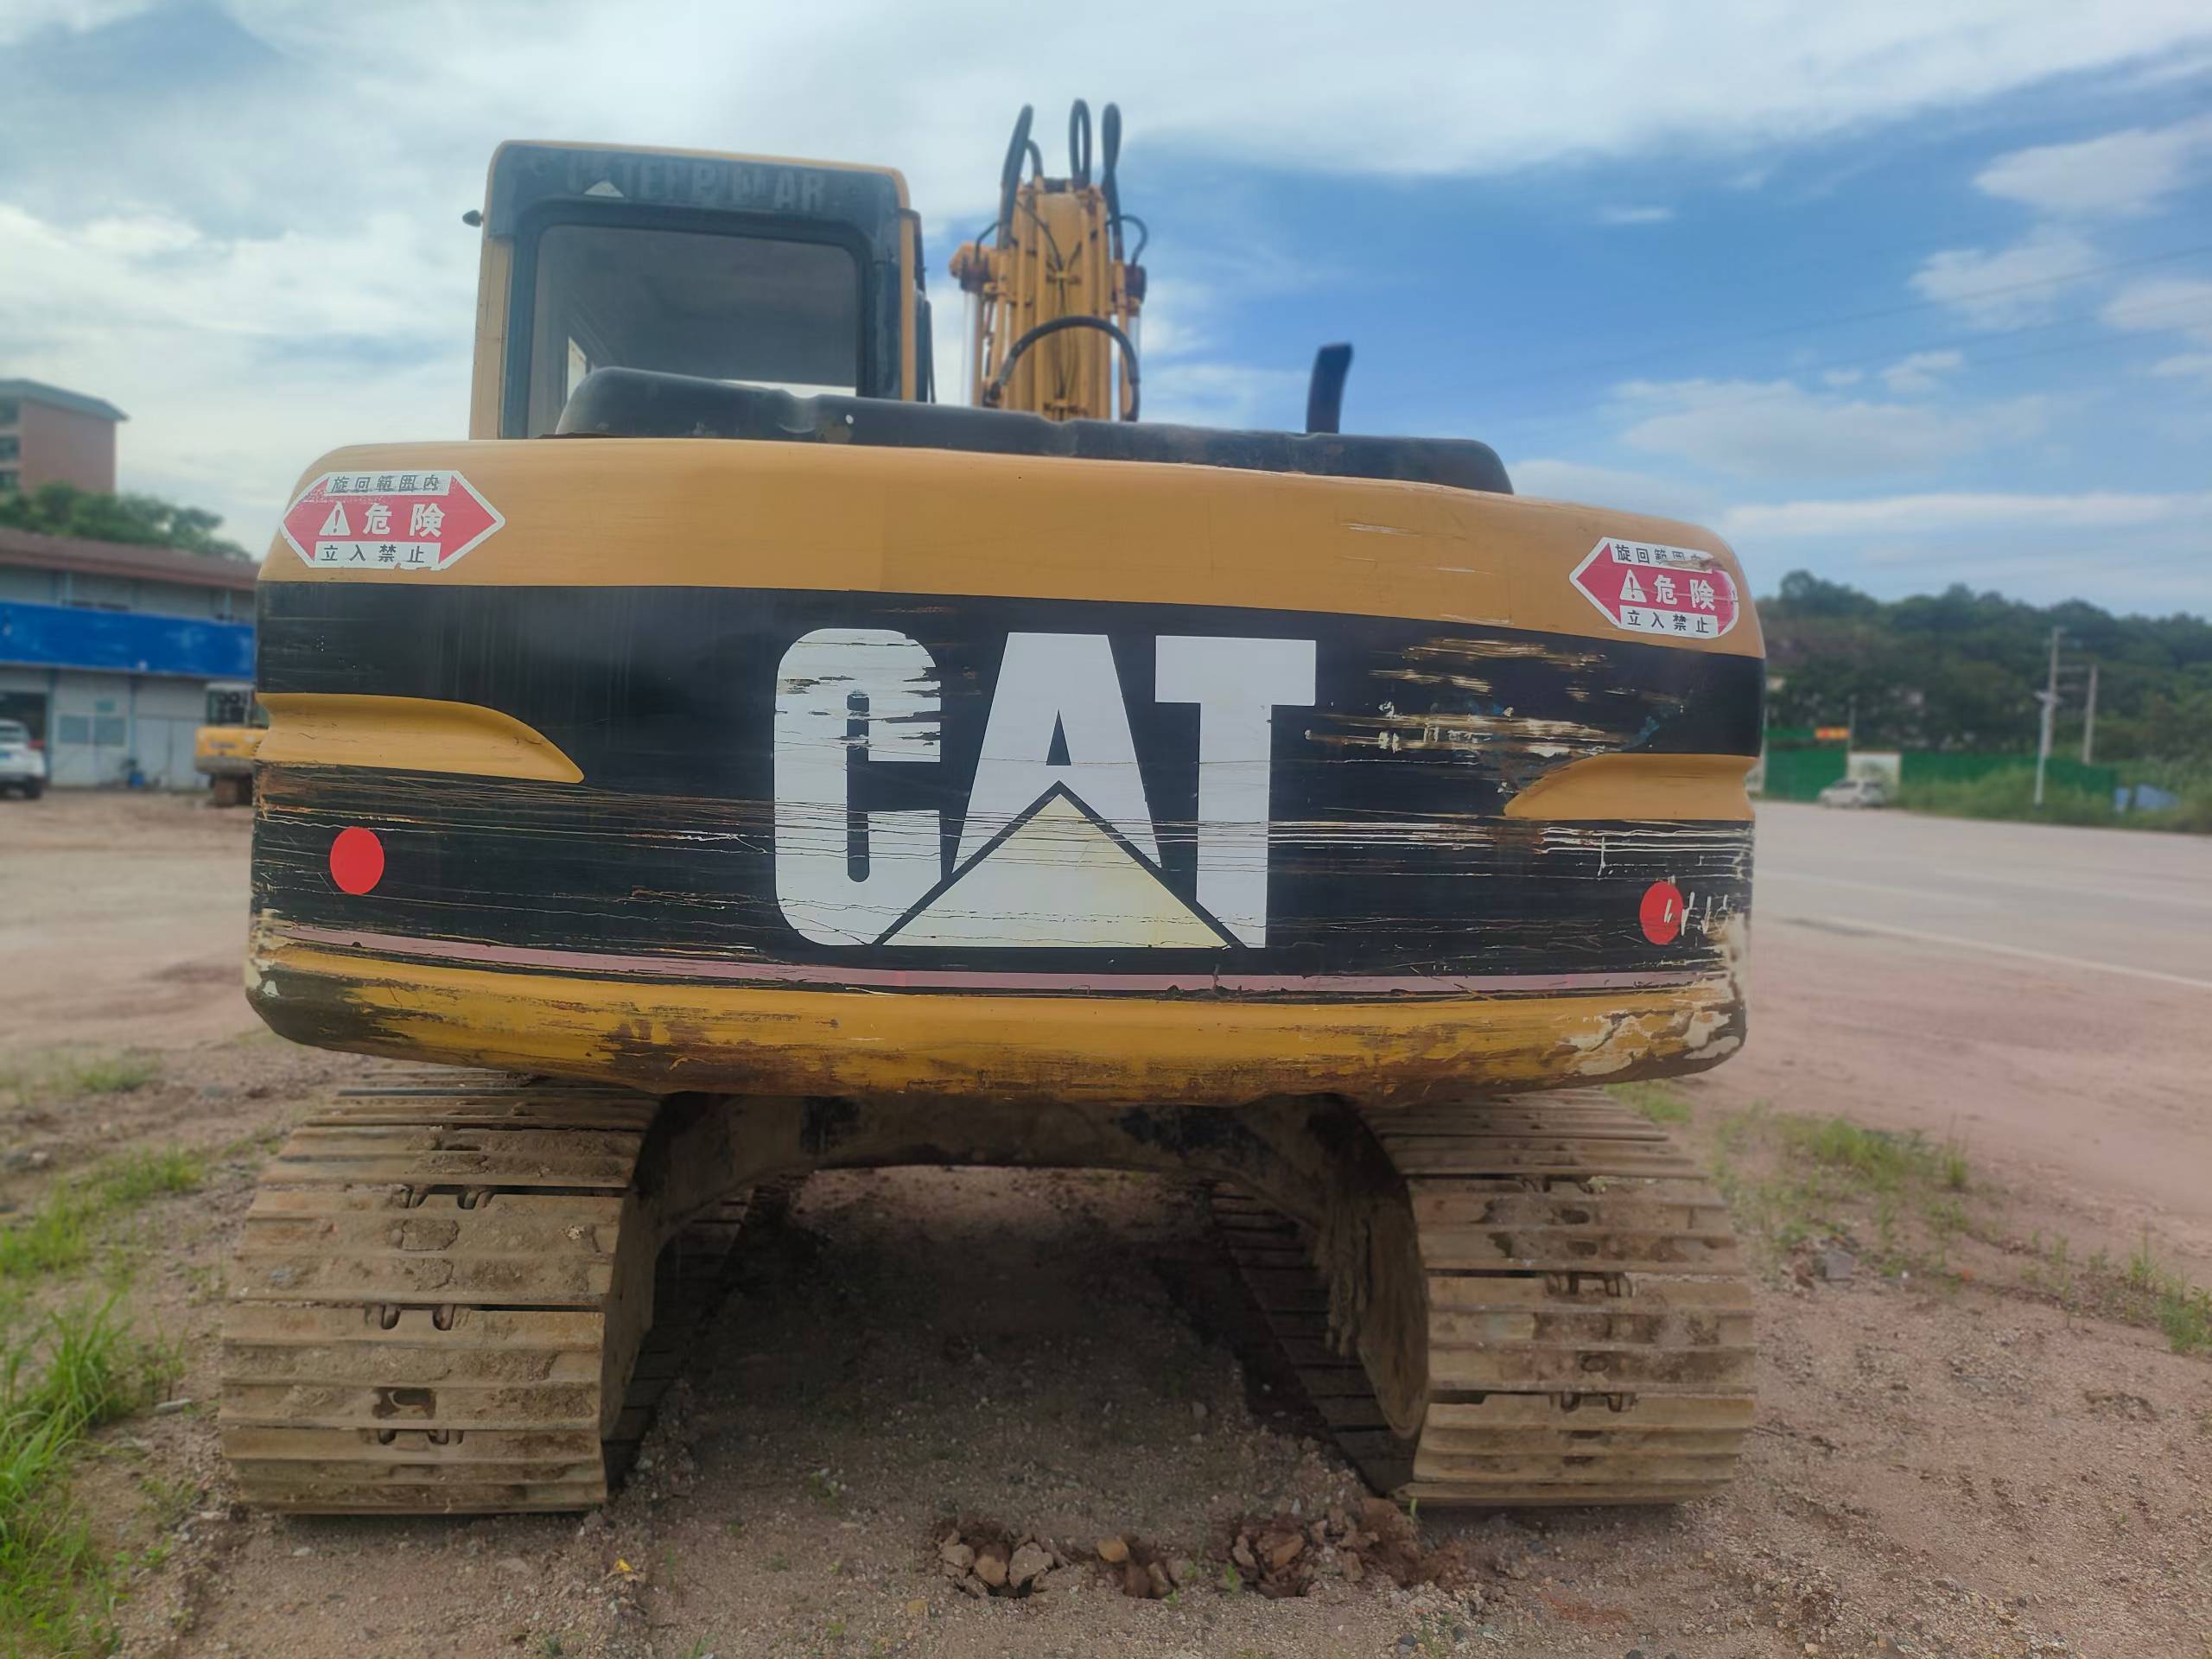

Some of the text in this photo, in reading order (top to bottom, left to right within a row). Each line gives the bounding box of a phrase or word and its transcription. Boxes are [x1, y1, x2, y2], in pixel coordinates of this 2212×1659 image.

[331, 474, 440, 493] 旋回範囲内
[363, 503, 446, 537] 危険
[321, 544, 425, 563] 立入禁止
[1653, 574, 1715, 611] 危険
[1627, 610, 1709, 634] 立入禁止
[774, 628, 1316, 949] CAT
